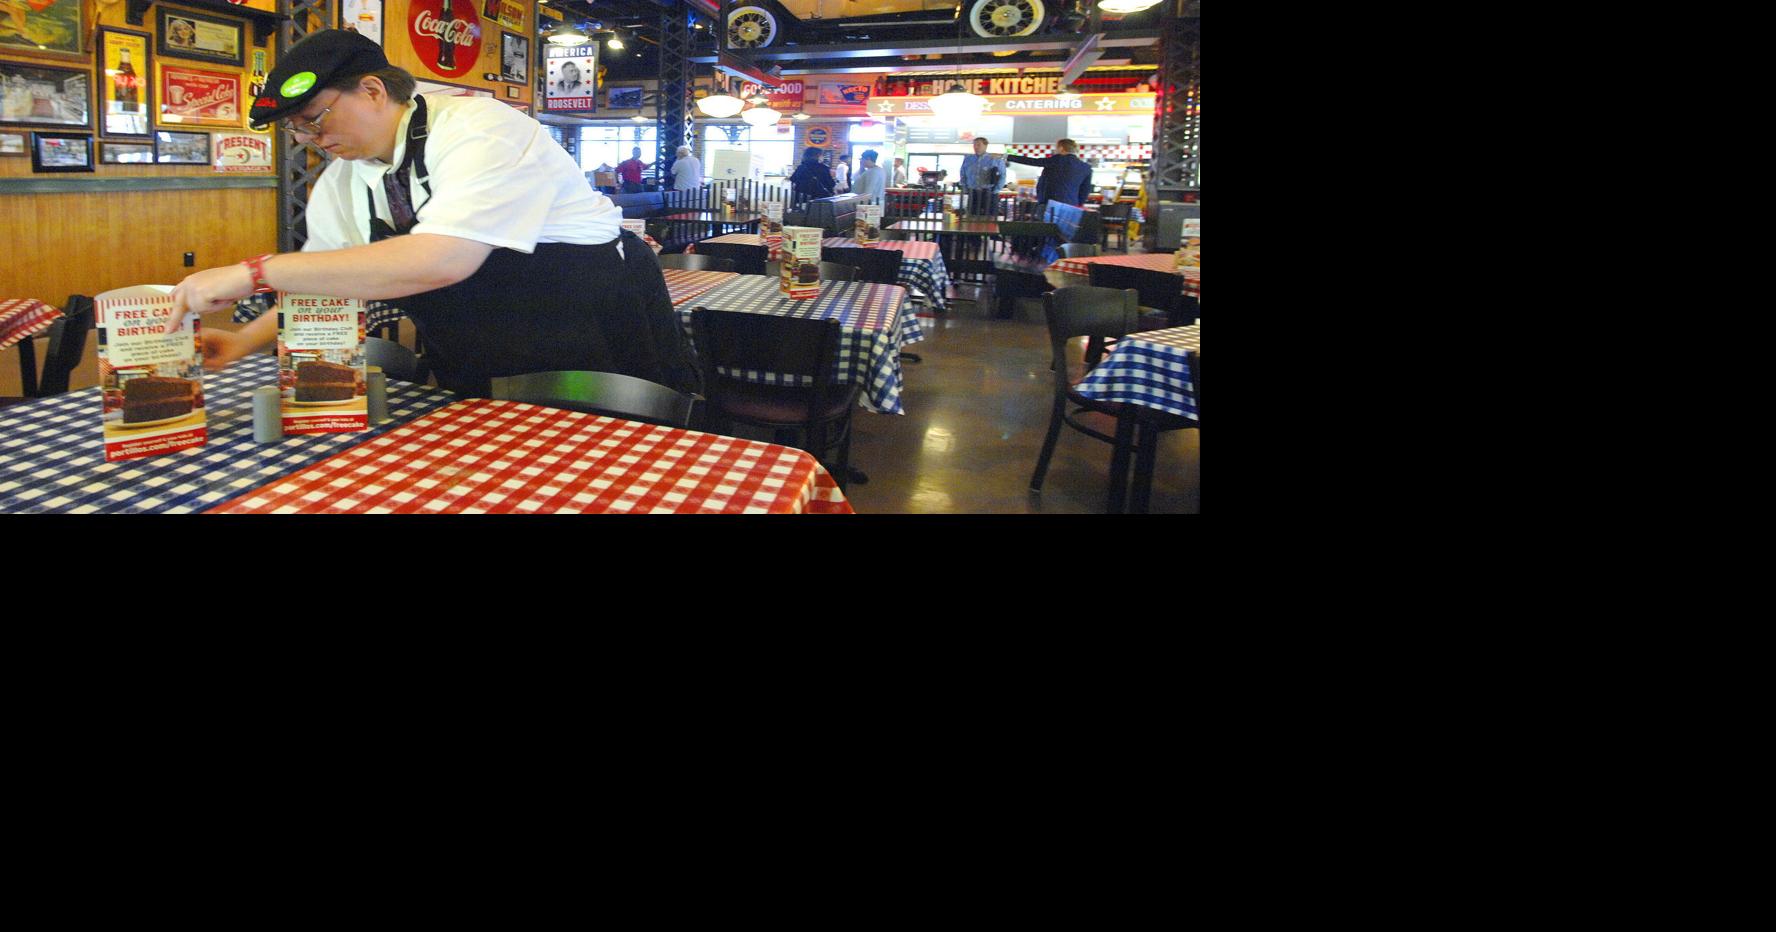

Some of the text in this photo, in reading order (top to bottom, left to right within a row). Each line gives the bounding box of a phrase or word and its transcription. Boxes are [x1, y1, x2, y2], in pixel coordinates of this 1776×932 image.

[549, 46, 593, 57] AMERICA
[773, 82, 802, 94] OOD
[932, 78, 983, 94] HOME
[548, 97, 592, 109] ROOSEVELT
[1006, 99, 1082, 109] CATERING
[216, 136, 267, 161] CRESCENT
[291, 298, 349, 307] FREE CAKE
[115, 307, 173, 319] FREE CA
[292, 314, 349, 322] BIRTHDAY!
[123, 319, 141, 327] on
